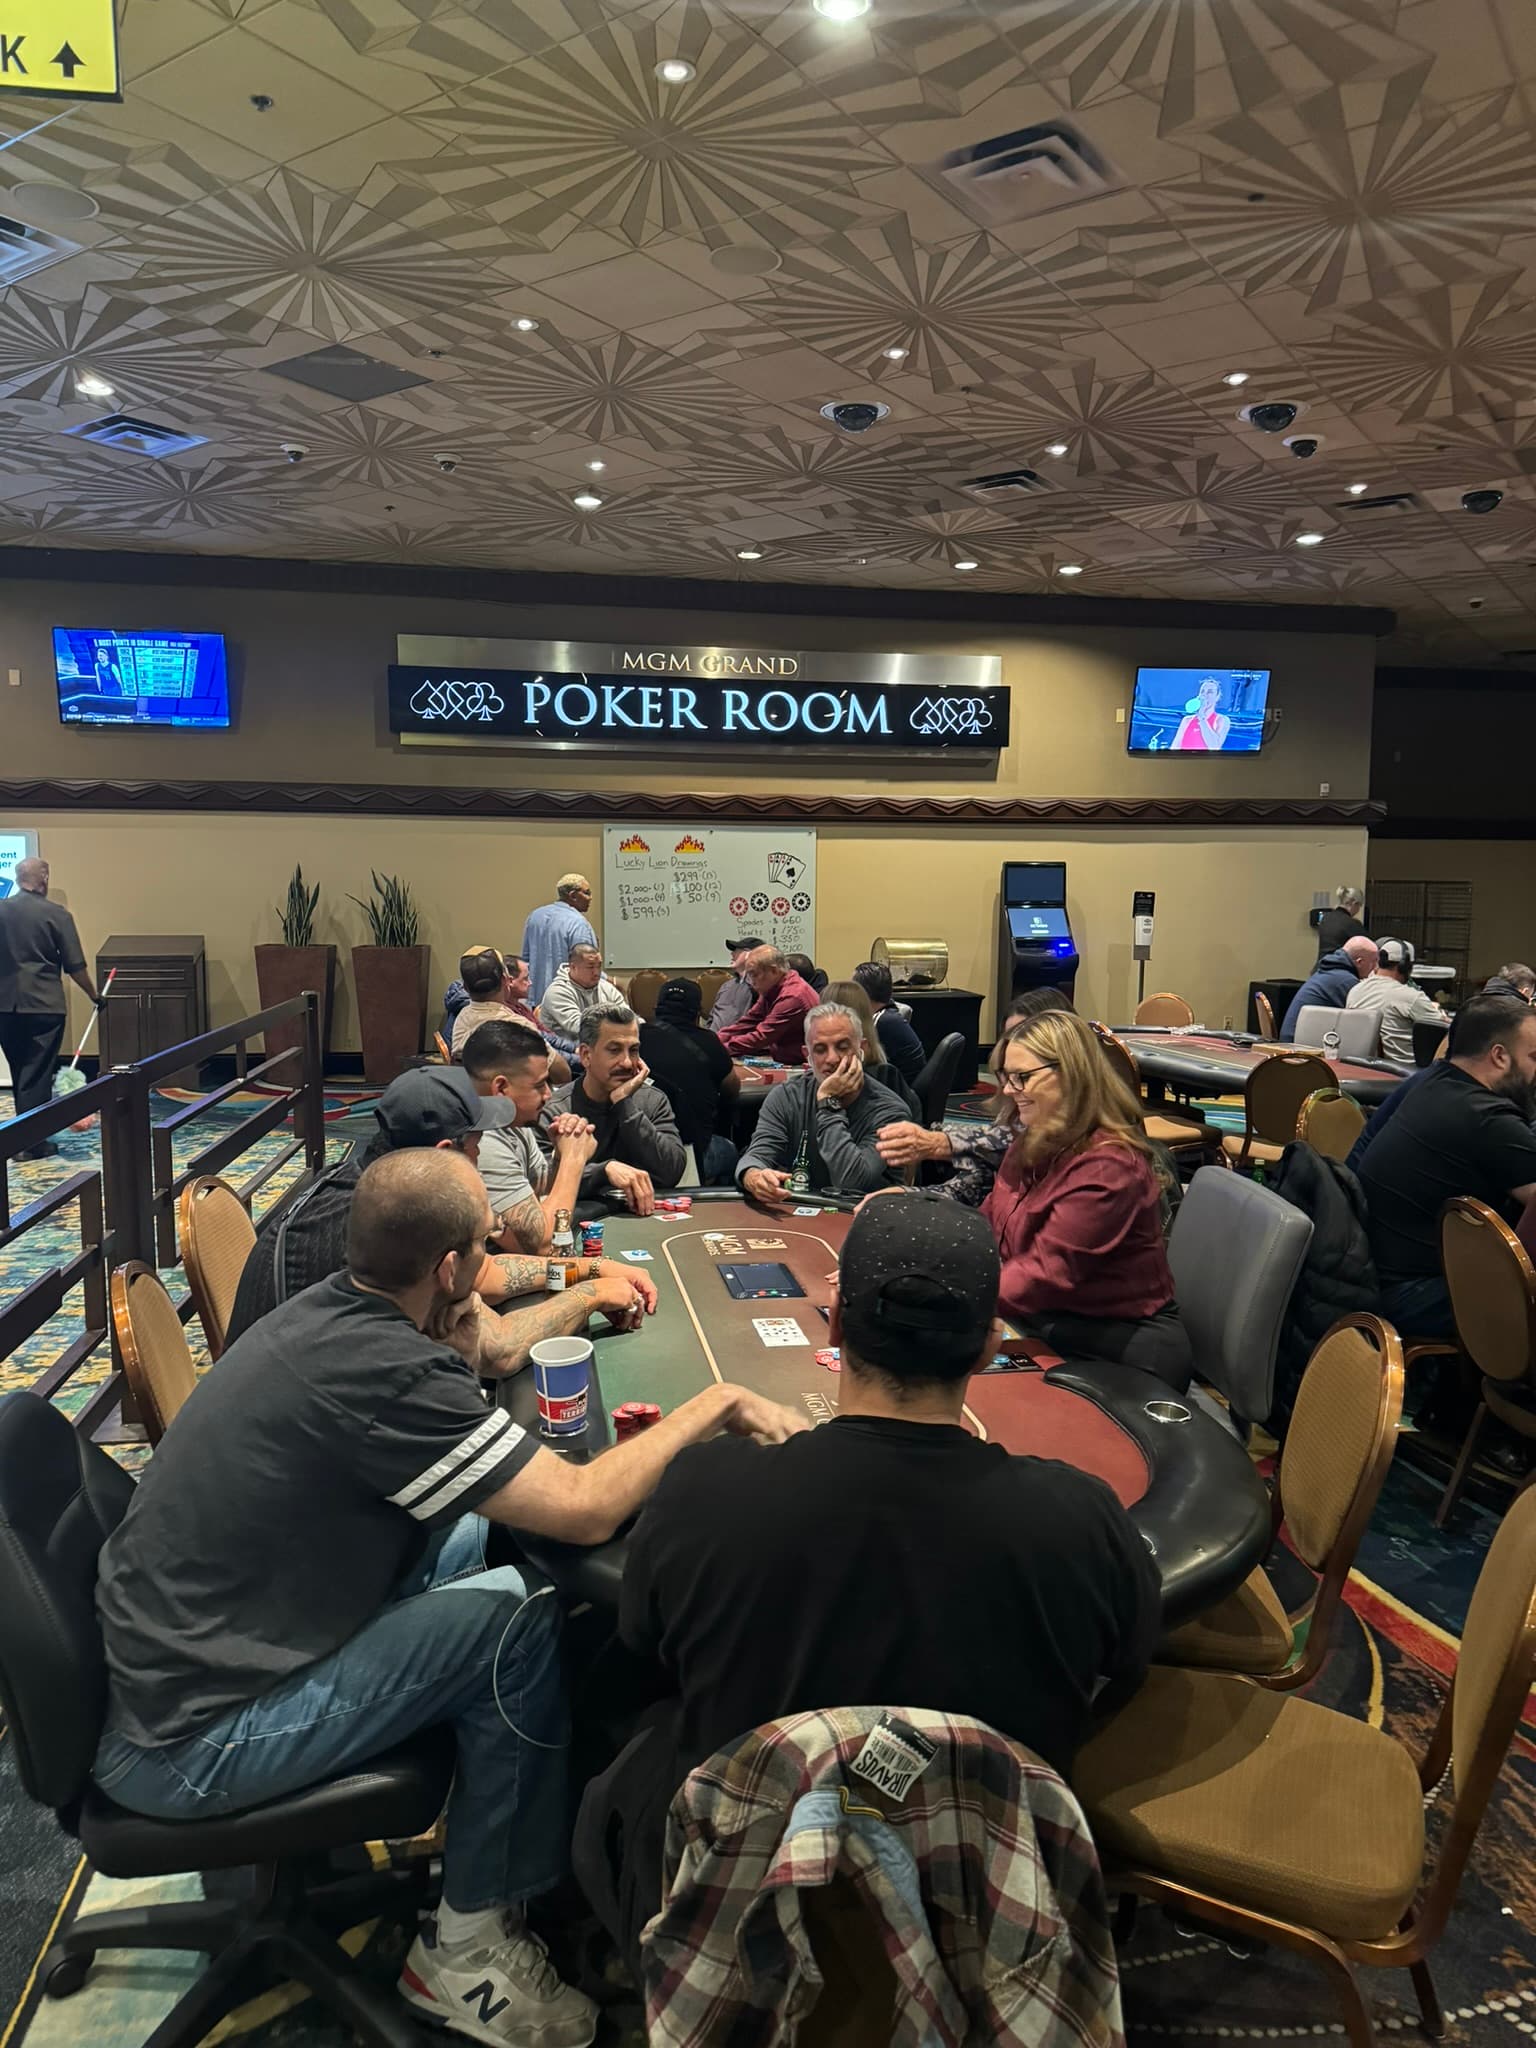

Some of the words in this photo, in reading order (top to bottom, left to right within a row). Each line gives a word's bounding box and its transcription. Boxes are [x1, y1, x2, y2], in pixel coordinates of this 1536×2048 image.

[0, 34, 28, 75] K
[622, 651, 693, 672] MGM
[700, 655, 798, 675] GRAND
[522, 682, 708, 730] POKER
[721, 689, 894, 734] ROOM
[615, 853, 646, 871] Lucky
[856, 1749, 912, 1798] DRAVUS
[462, 1979, 512, 2025] N
